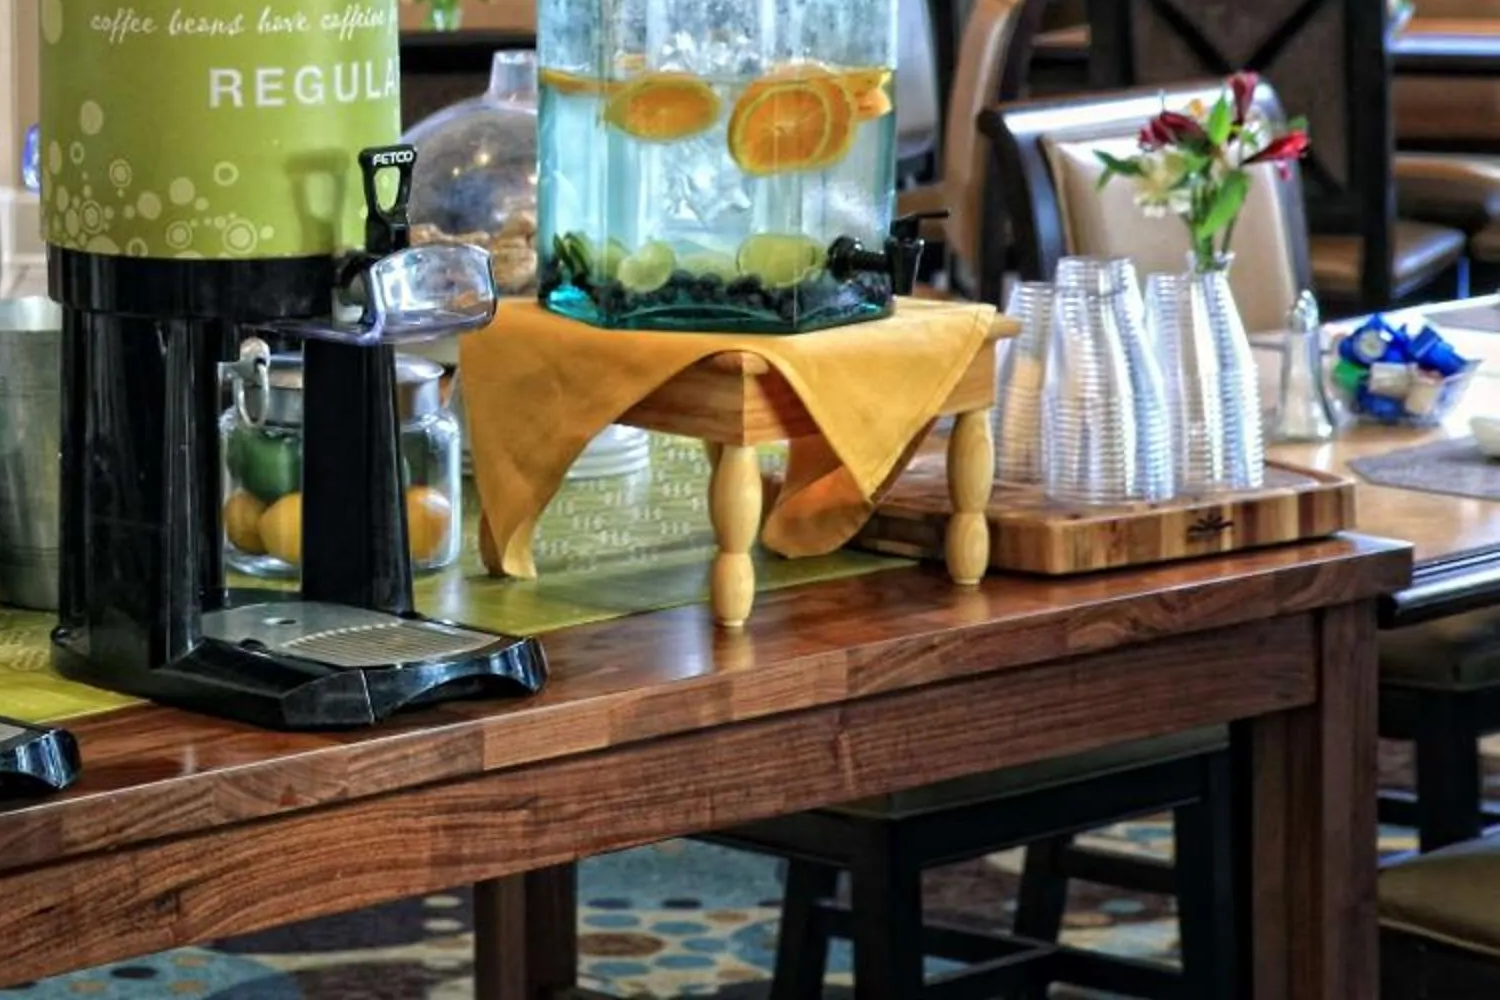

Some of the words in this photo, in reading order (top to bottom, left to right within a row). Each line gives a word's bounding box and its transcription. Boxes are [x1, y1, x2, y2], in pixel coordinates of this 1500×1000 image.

[90, 6, 158, 44] coffee
[168, 7, 246, 37] beans
[257, 5, 310, 34] have
[209, 58, 400, 108] REGULA
[372, 150, 414, 167] FETCO
